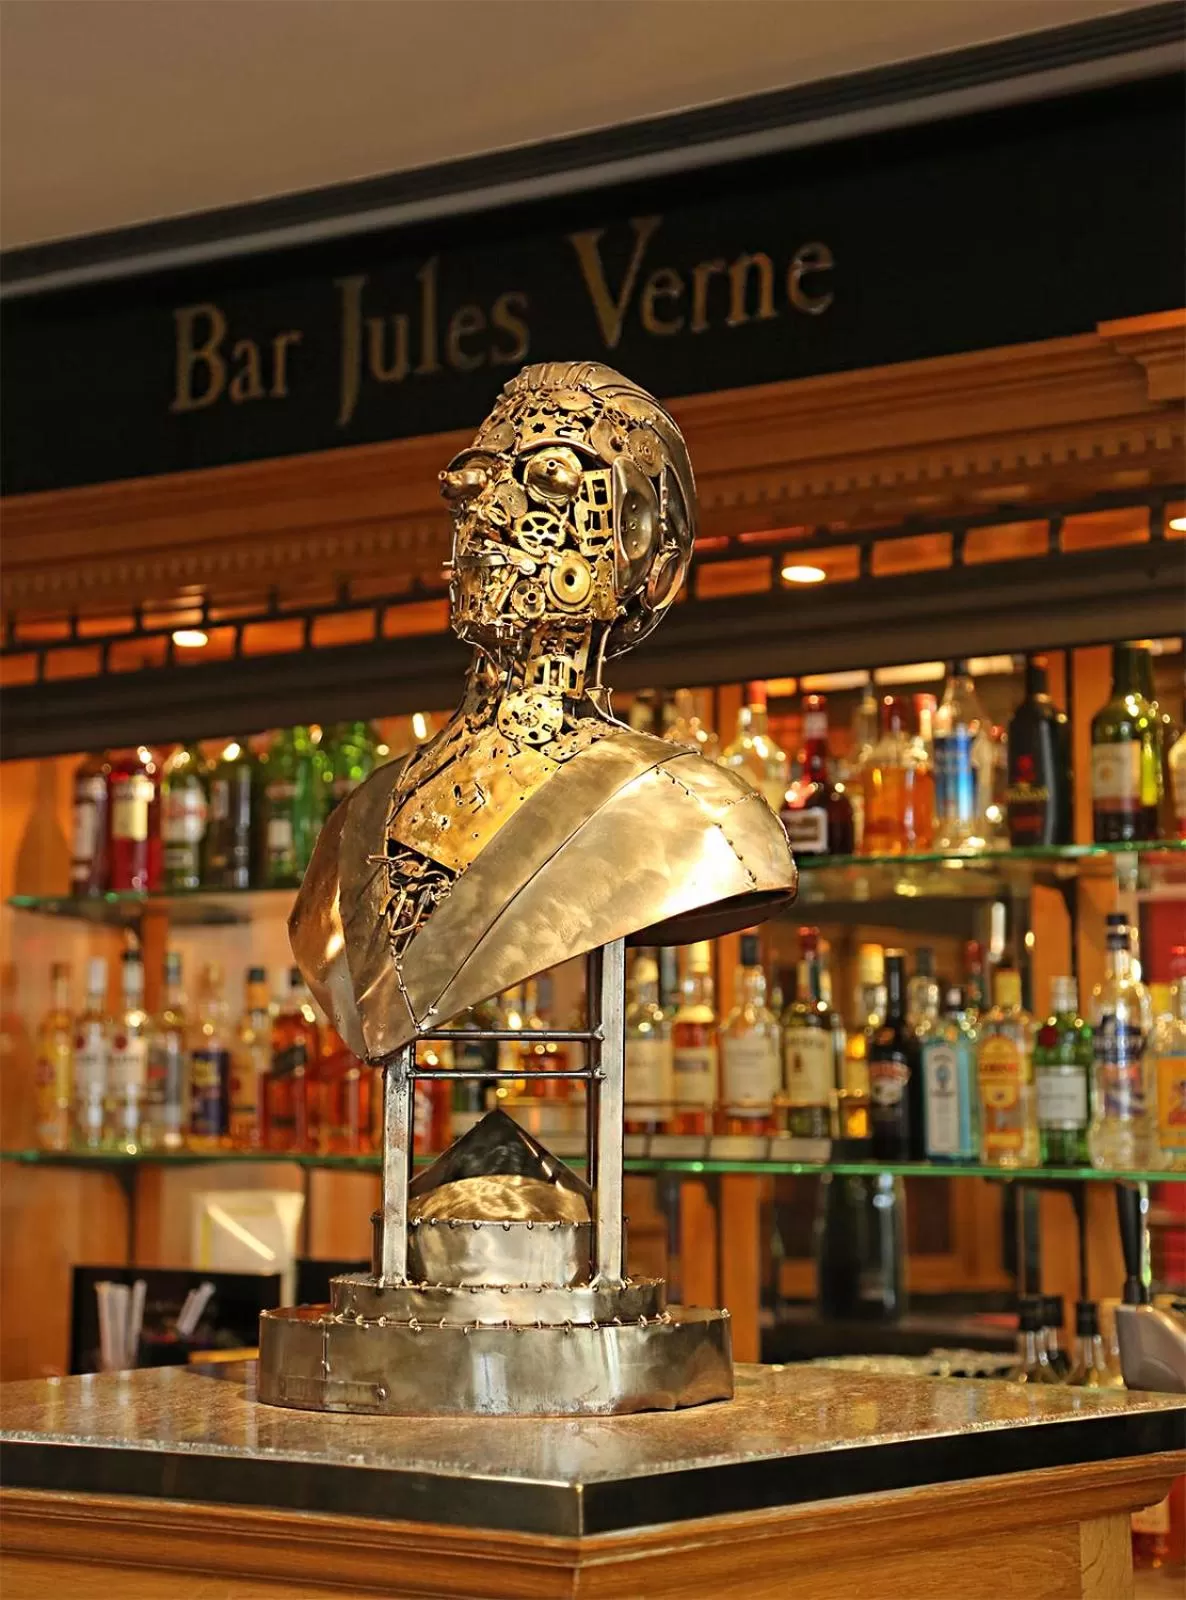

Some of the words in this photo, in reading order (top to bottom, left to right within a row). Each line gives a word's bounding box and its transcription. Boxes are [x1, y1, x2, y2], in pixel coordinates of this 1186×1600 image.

[170, 304, 301, 412] Bar
[334, 256, 530, 426] Jules
[569, 216, 836, 348] Verne
